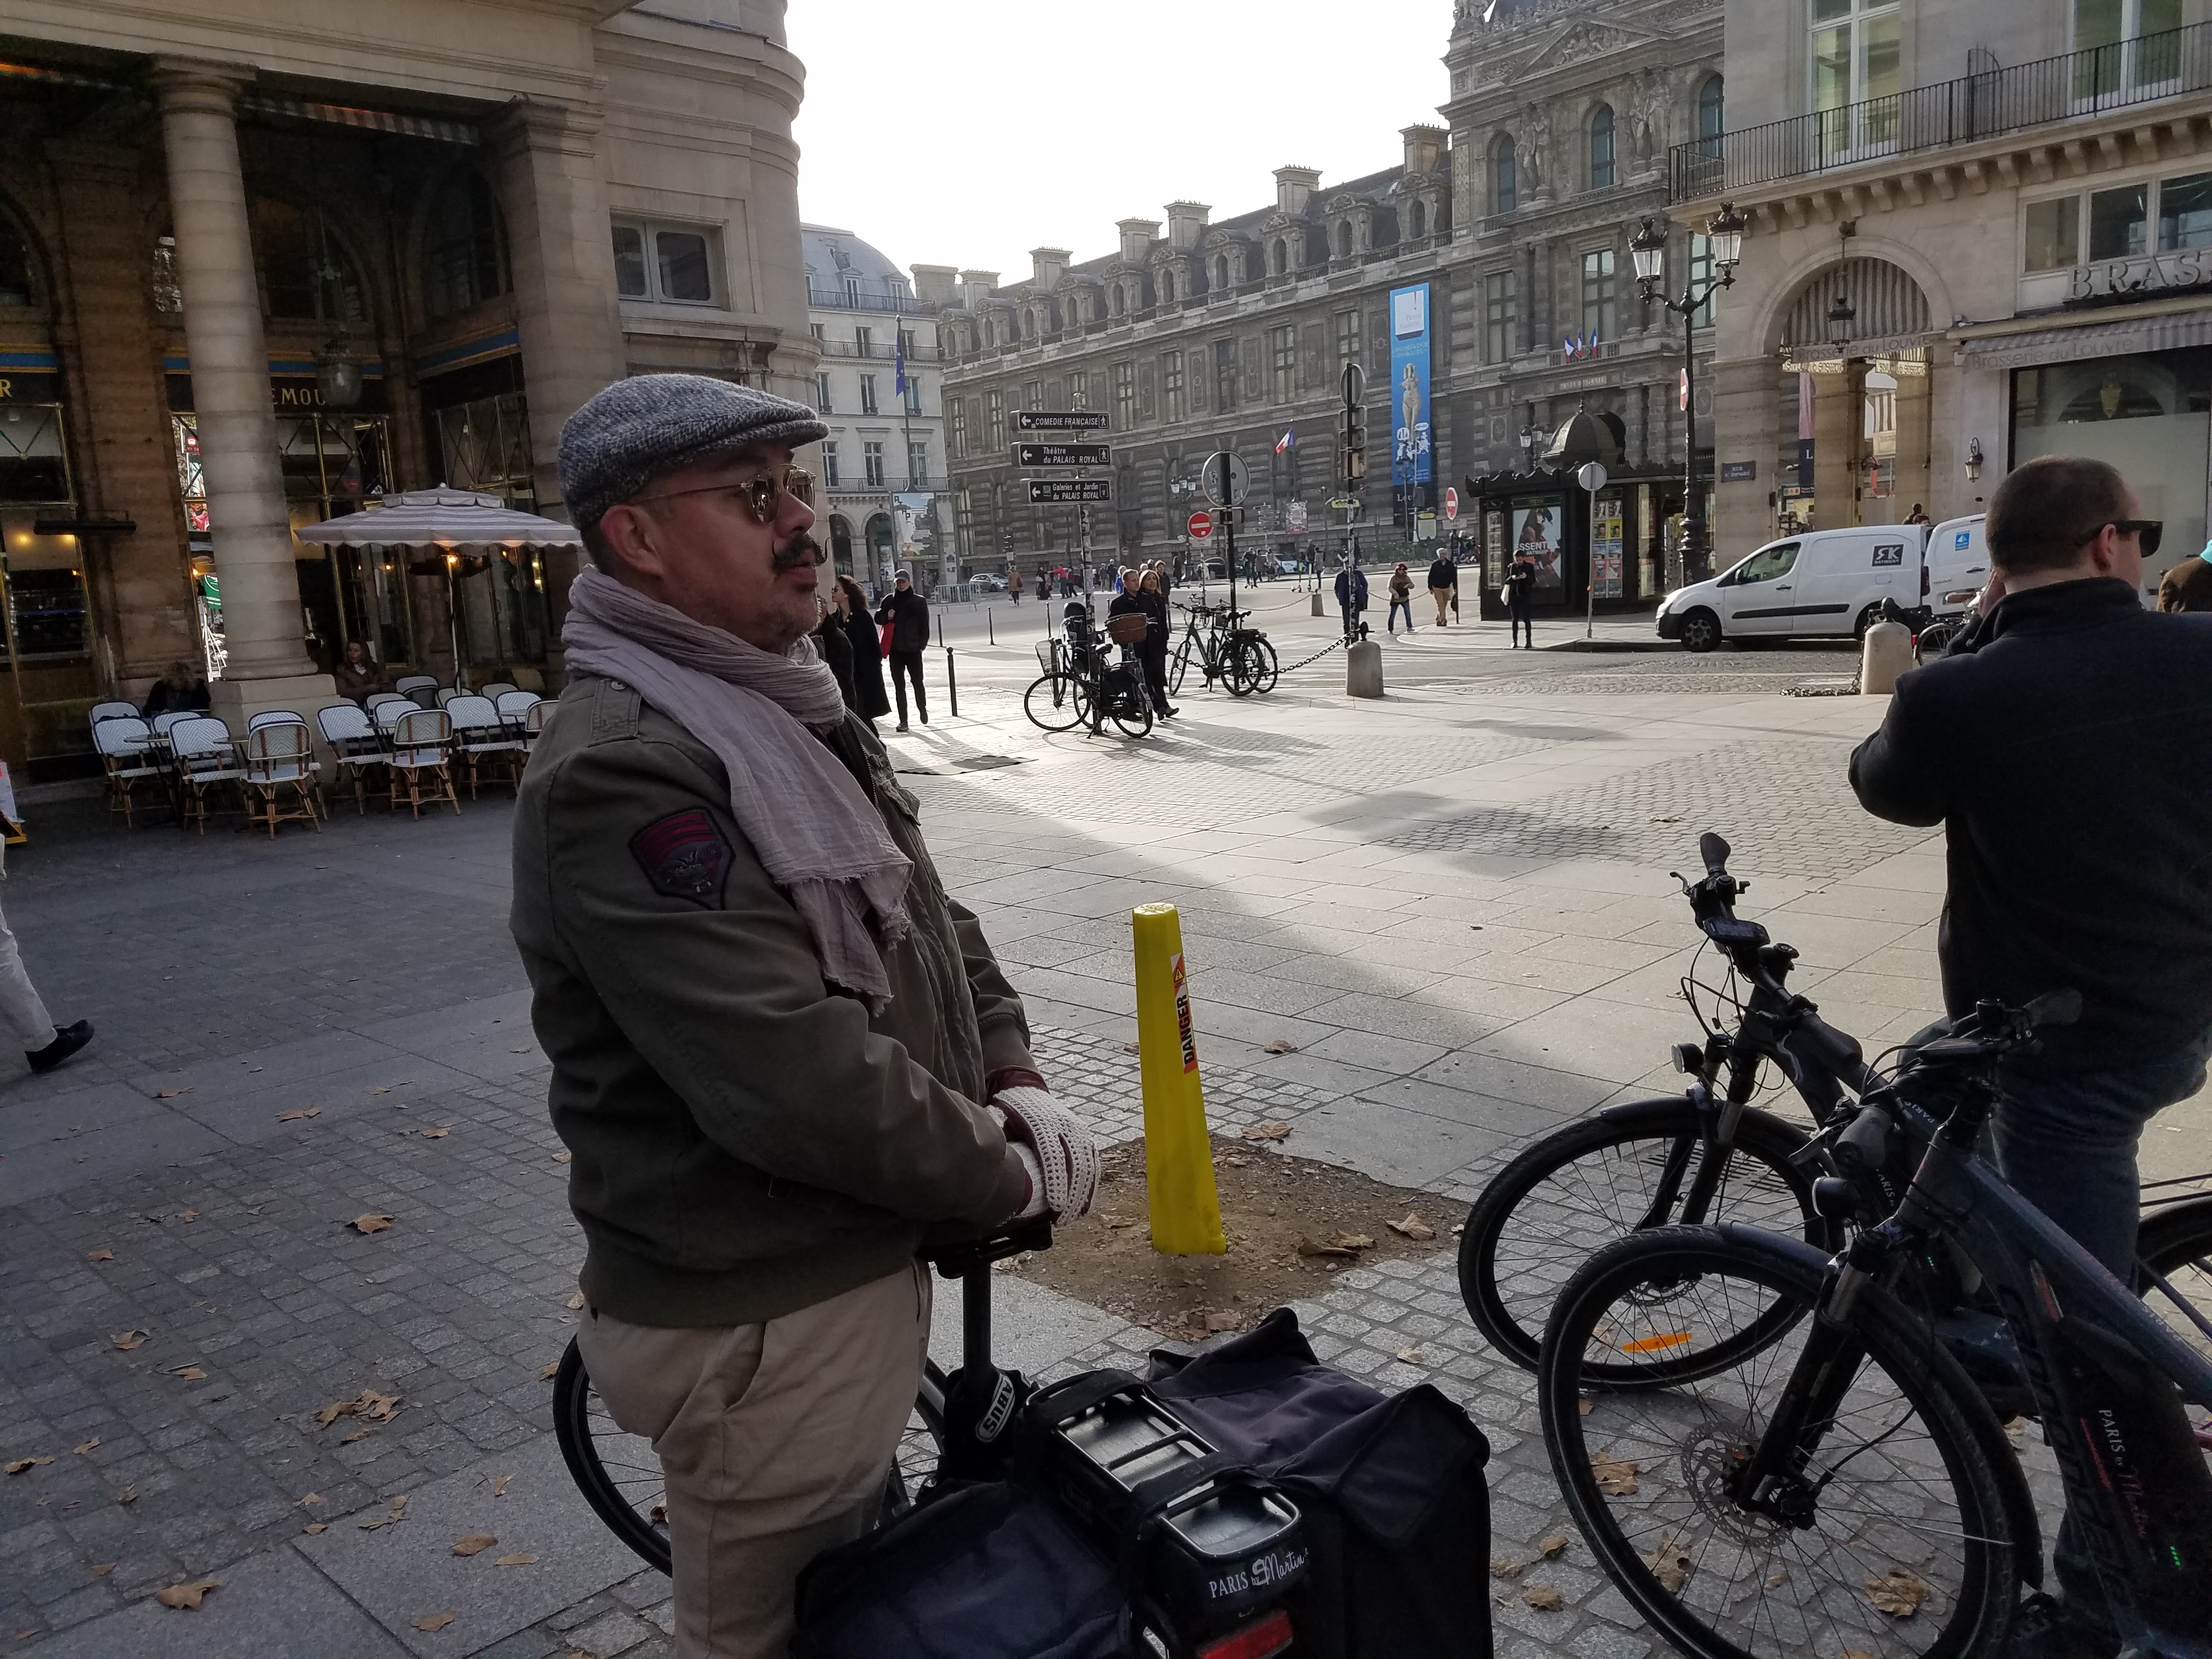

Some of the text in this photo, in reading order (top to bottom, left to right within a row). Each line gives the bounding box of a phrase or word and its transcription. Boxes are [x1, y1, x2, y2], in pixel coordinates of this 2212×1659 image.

[2062, 251, 2211, 301] BRAS
[1972, 339, 2134, 368] Brasserie du Louvre
[1064, 417, 1098, 426] FRANÇAISE
[1176, 994, 1195, 1065] DANGER
[1876, 1169, 1895, 1197] ARIS
[983, 1379, 1013, 1434] ABUS
[2098, 1409, 2126, 1454] PARIS
[1209, 1571, 1249, 1599] PARIS
